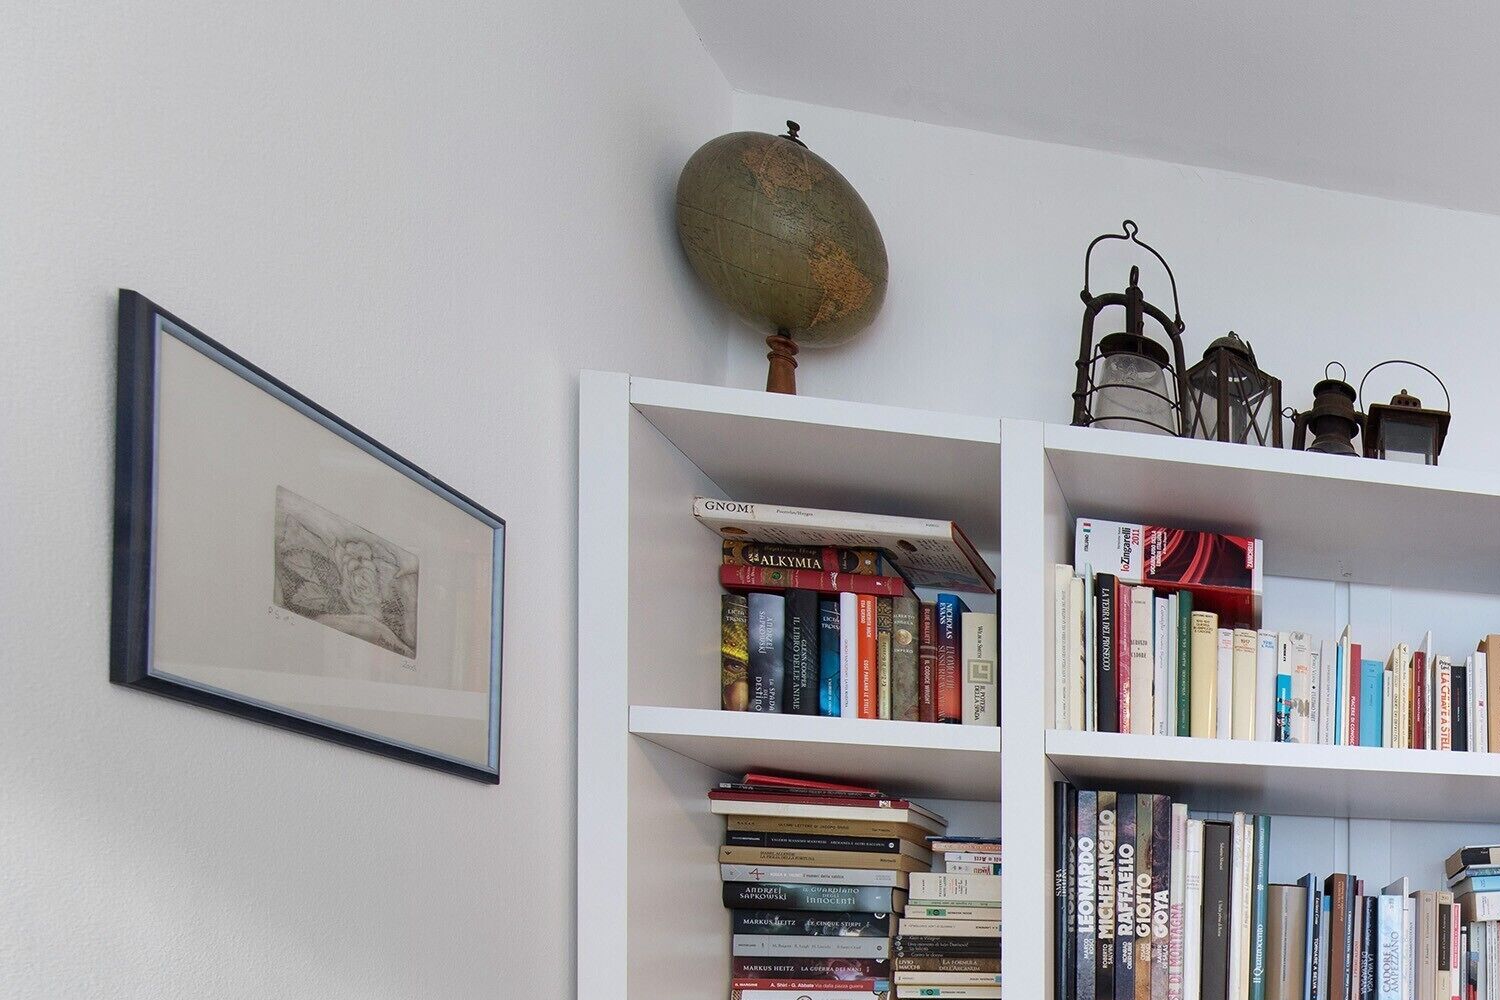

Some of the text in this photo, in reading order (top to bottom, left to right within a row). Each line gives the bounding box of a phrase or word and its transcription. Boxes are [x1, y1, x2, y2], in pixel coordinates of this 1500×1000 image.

[760, 555, 822, 569] ALKYMIA
[1102, 588, 1109, 598] LA
[758, 611, 766, 654] SAPKOWSKI
[740, 892, 787, 901] SAPKOWSKI
[1078, 837, 1094, 932] LEONARDO
[1099, 810, 1114, 939] MICHELANGELO
[1118, 844, 1134, 935] RAFFAELLO
[1136, 873, 1151, 937] GIOTTO
[1154, 890, 1168, 938] GOYA
[1170, 903, 1183, 967] MONTAGNA
[1253, 924, 1264, 976] Quattrocento
[1367, 954, 1373, 962] LA
[1382, 950, 1391, 993] CADORE
[1390, 931, 1399, 992] AMPEZZANO
